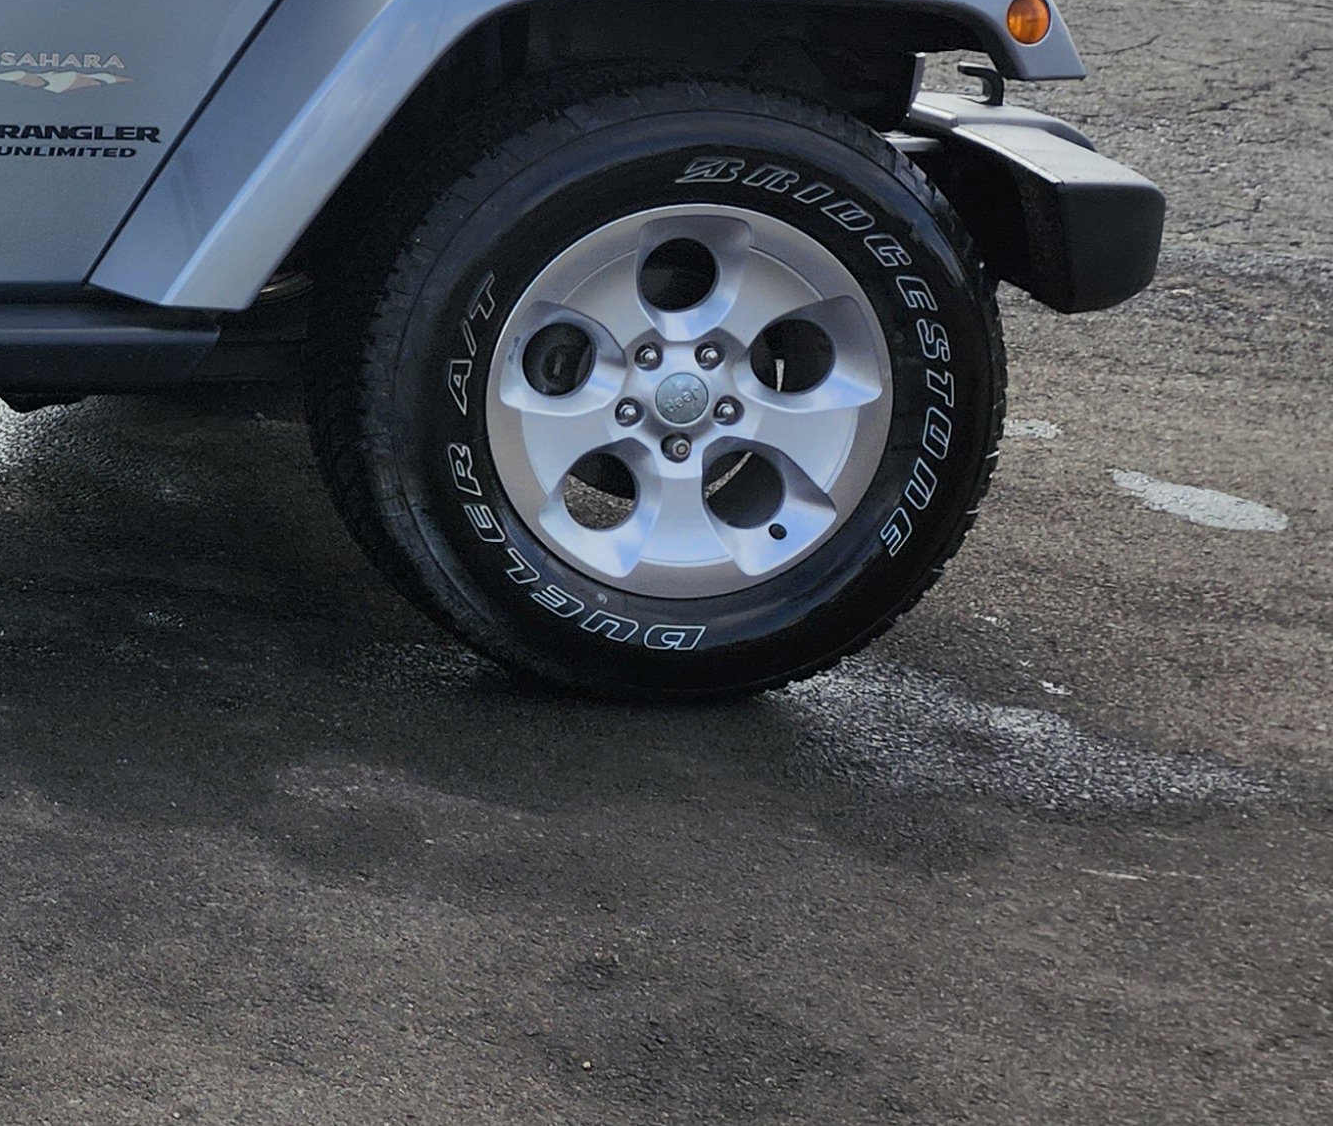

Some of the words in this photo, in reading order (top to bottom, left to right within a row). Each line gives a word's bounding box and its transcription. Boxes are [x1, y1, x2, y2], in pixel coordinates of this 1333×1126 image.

[0, 51, 125, 69] SAHARA
[447, 270, 498, 416] A/T
[675, 156, 955, 557] BRIDGESTONE
[446, 443, 707, 652] DUELER
